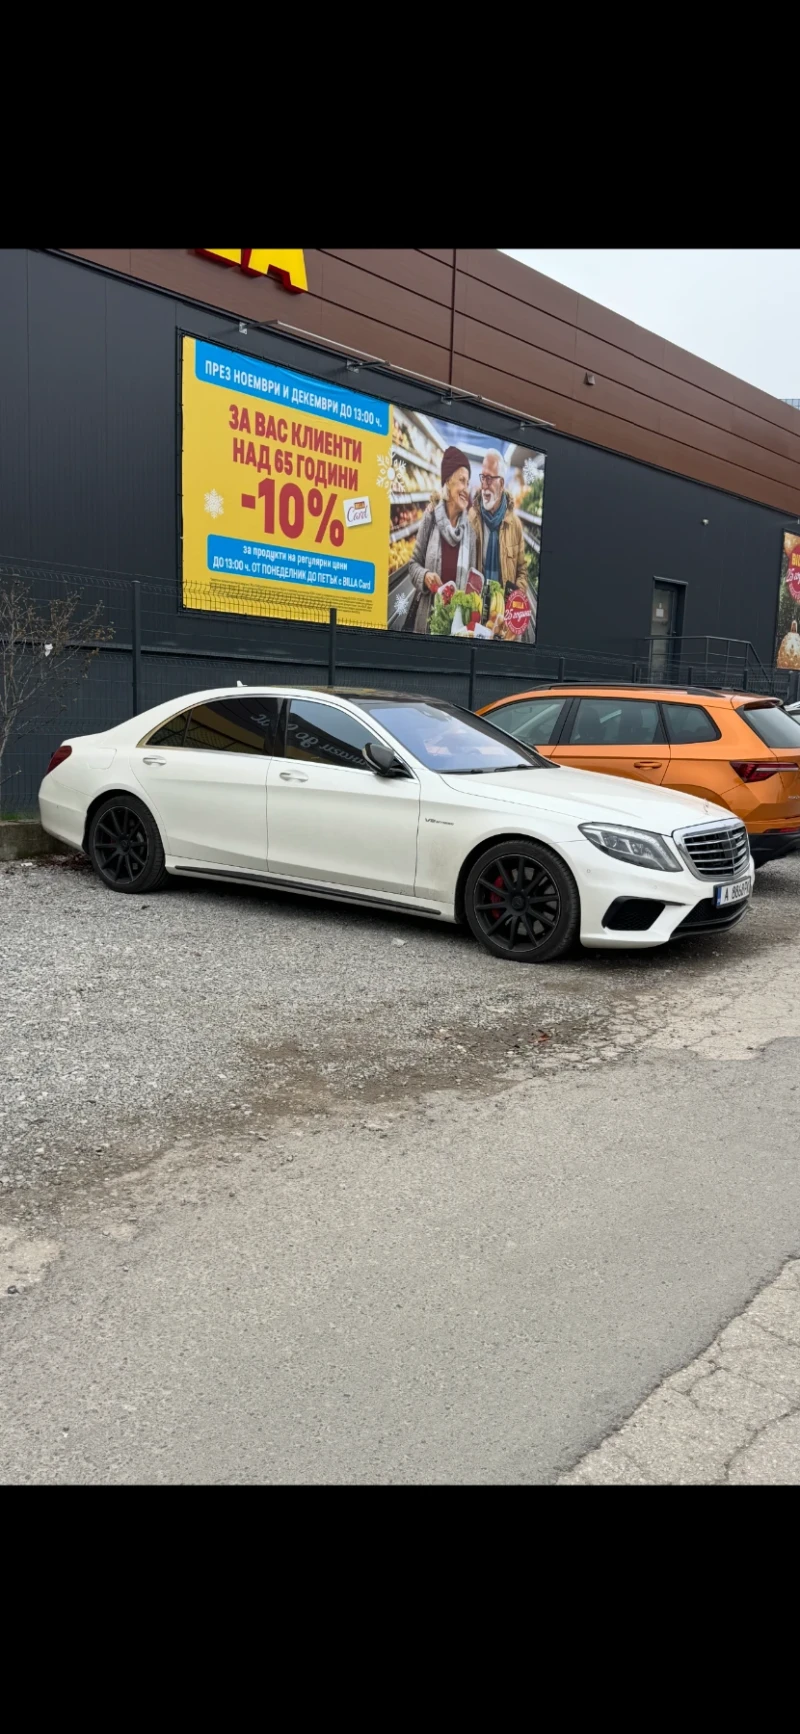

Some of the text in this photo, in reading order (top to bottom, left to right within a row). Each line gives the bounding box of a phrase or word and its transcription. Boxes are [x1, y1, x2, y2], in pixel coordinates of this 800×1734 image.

[204, 360, 383, 428] ПРЕЗ НОЕМВРИ И ДЕКЕМВРИ ДО 13:00 ч.
[228, 404, 362, 464] ЗА ВАС КЛИЕНТИ
[232, 438, 358, 492] НАД 65 ГОДИНИ
[241, 477, 345, 548] -10%
[213, 556, 224, 569] ДО
[225, 558, 244, 570] 13:00
[244, 564, 251, 572] ч.
[252, 562, 261, 572] ОТ
[262, 564, 306, 580] ПОНЕДЕЛНИК
[307, 570, 317, 582] ДО
[318, 572, 338, 585] ПЕТЪК
[342, 576, 358, 588] BILLA
[358, 579, 371, 590] Card
[242, 546, 348, 571] за продукти на регулярни цени
[504, 609, 514, 620] 25
[724, 888, 728, 902] A
